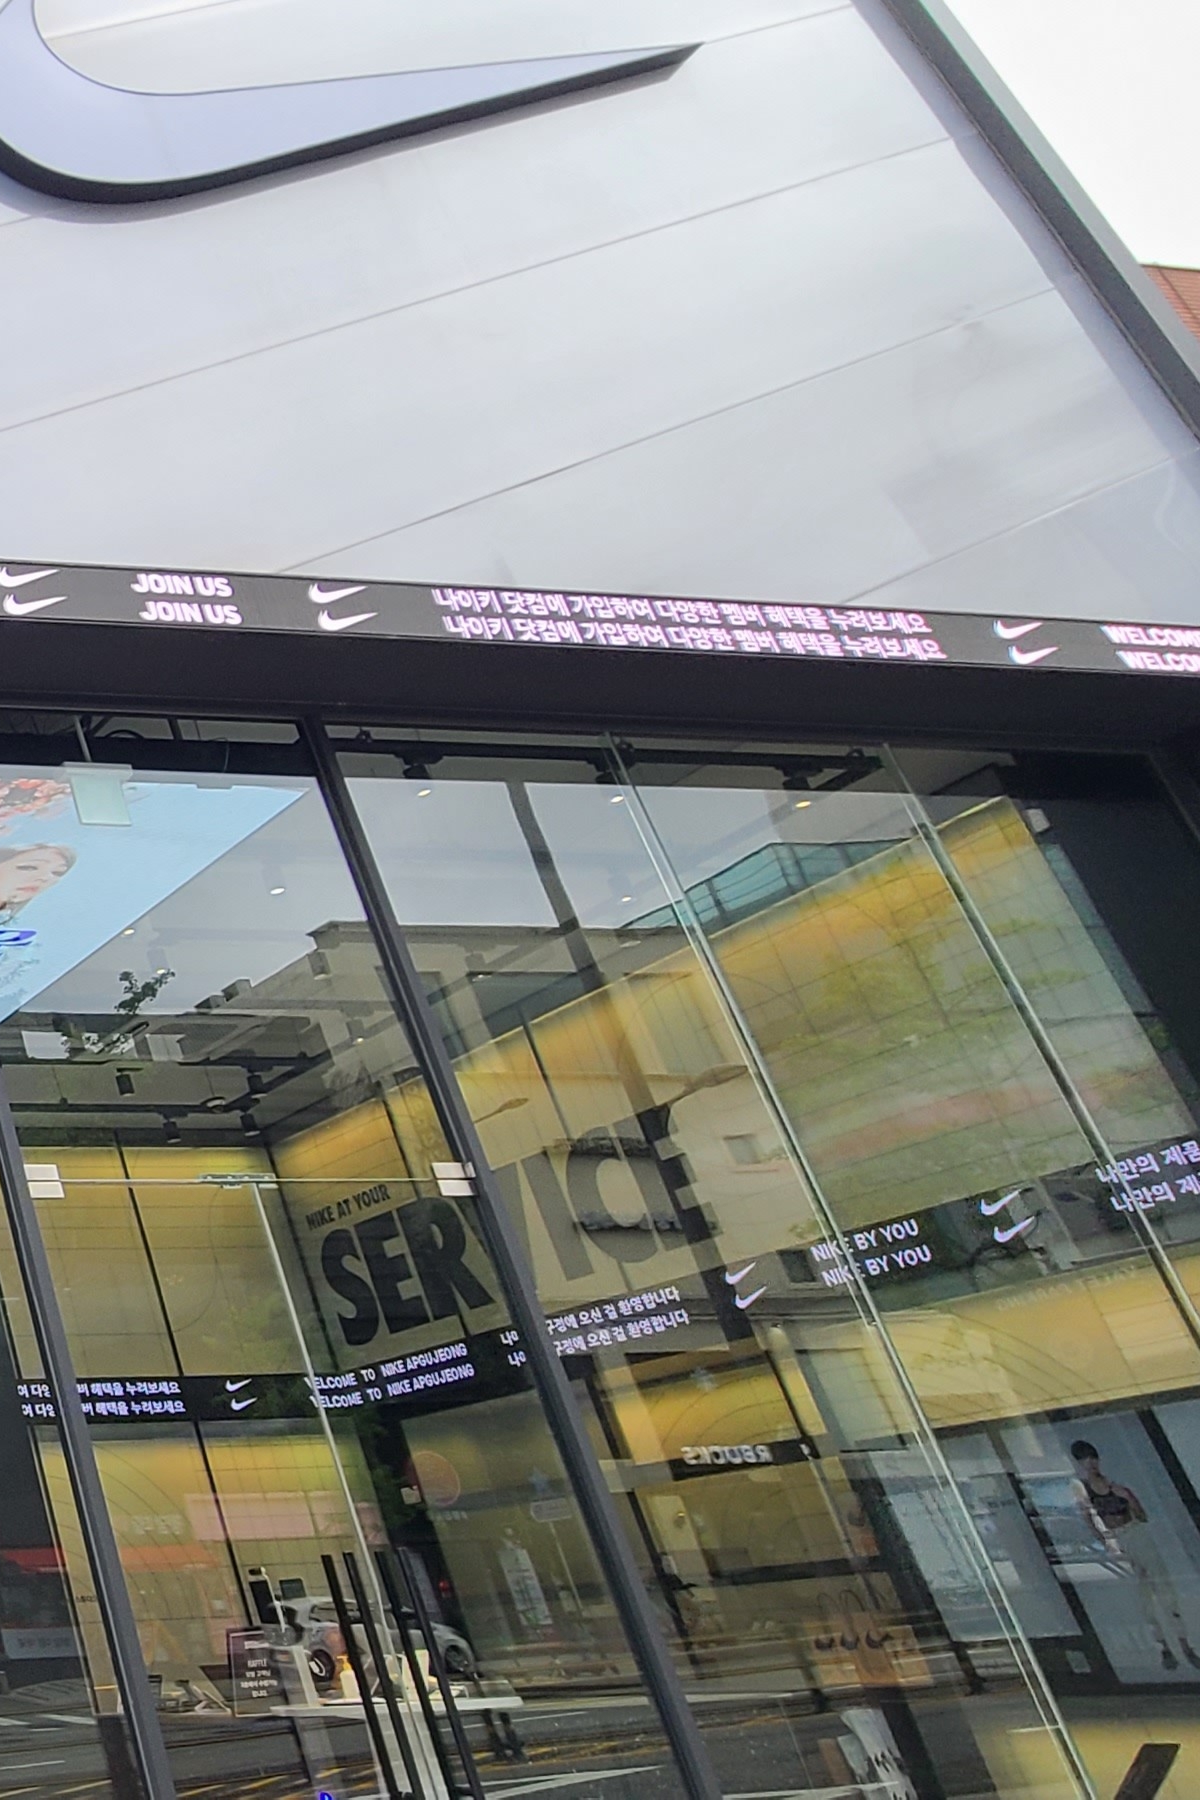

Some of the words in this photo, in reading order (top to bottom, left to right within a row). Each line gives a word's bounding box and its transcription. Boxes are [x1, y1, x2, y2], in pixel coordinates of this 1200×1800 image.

[130, 573, 195, 595] JOIN
[192, 576, 233, 597] US
[138, 601, 204, 623] JOIN
[201, 604, 242, 625] US
[431, 588, 503, 613] 나이키
[500, 591, 571, 617] 닷컴에
[567, 595, 656, 621] 가입하여
[654, 600, 722, 624] 다양한
[718, 603, 767, 627] 멤버
[762, 605, 831, 630] 혜택을
[825, 608, 933, 634] 누려보세요
[442, 615, 515, 640] 나이키
[510, 618, 583, 644] 닷컴에
[578, 621, 669, 648] 가입하여
[665, 626, 735, 650] 다양한
[730, 629, 780, 653] 멤버
[776, 631, 844, 657] 혜택을
[840, 635, 947, 660] 누려보세요
[1095, 1153, 1160, 1183] 나만의
[305, 1205, 336, 1231] NIKE
[336, 1198, 352, 1219] AT
[352, 1184, 391, 1210] YOUR
[1110, 1182, 1176, 1212] 나만의
[853, 1229, 878, 1250] BY
[878, 1218, 919, 1243] YOU
[865, 1255, 890, 1276] BY
[890, 1244, 932, 1269] YOU
[578, 1306, 604, 1326] 오신
[603, 1304, 618, 1320] 걸
[617, 1285, 681, 1316] 환영합니다
[586, 1329, 613, 1348] 오신
[611, 1325, 627, 1342] 걸
[627, 1308, 690, 1338] 환영합니다
[361, 1368, 376, 1383] TO
[380, 1360, 406, 1378] NIKE
[406, 1343, 468, 1372] APGUJEONG
[126, 1381, 181, 1396] 누려보세요
[367, 1387, 382, 1401] TO
[387, 1379, 413, 1397] NIKE
[412, 1363, 475, 1390] APGUJEONG
[131, 1400, 186, 1415] 누려보세요
